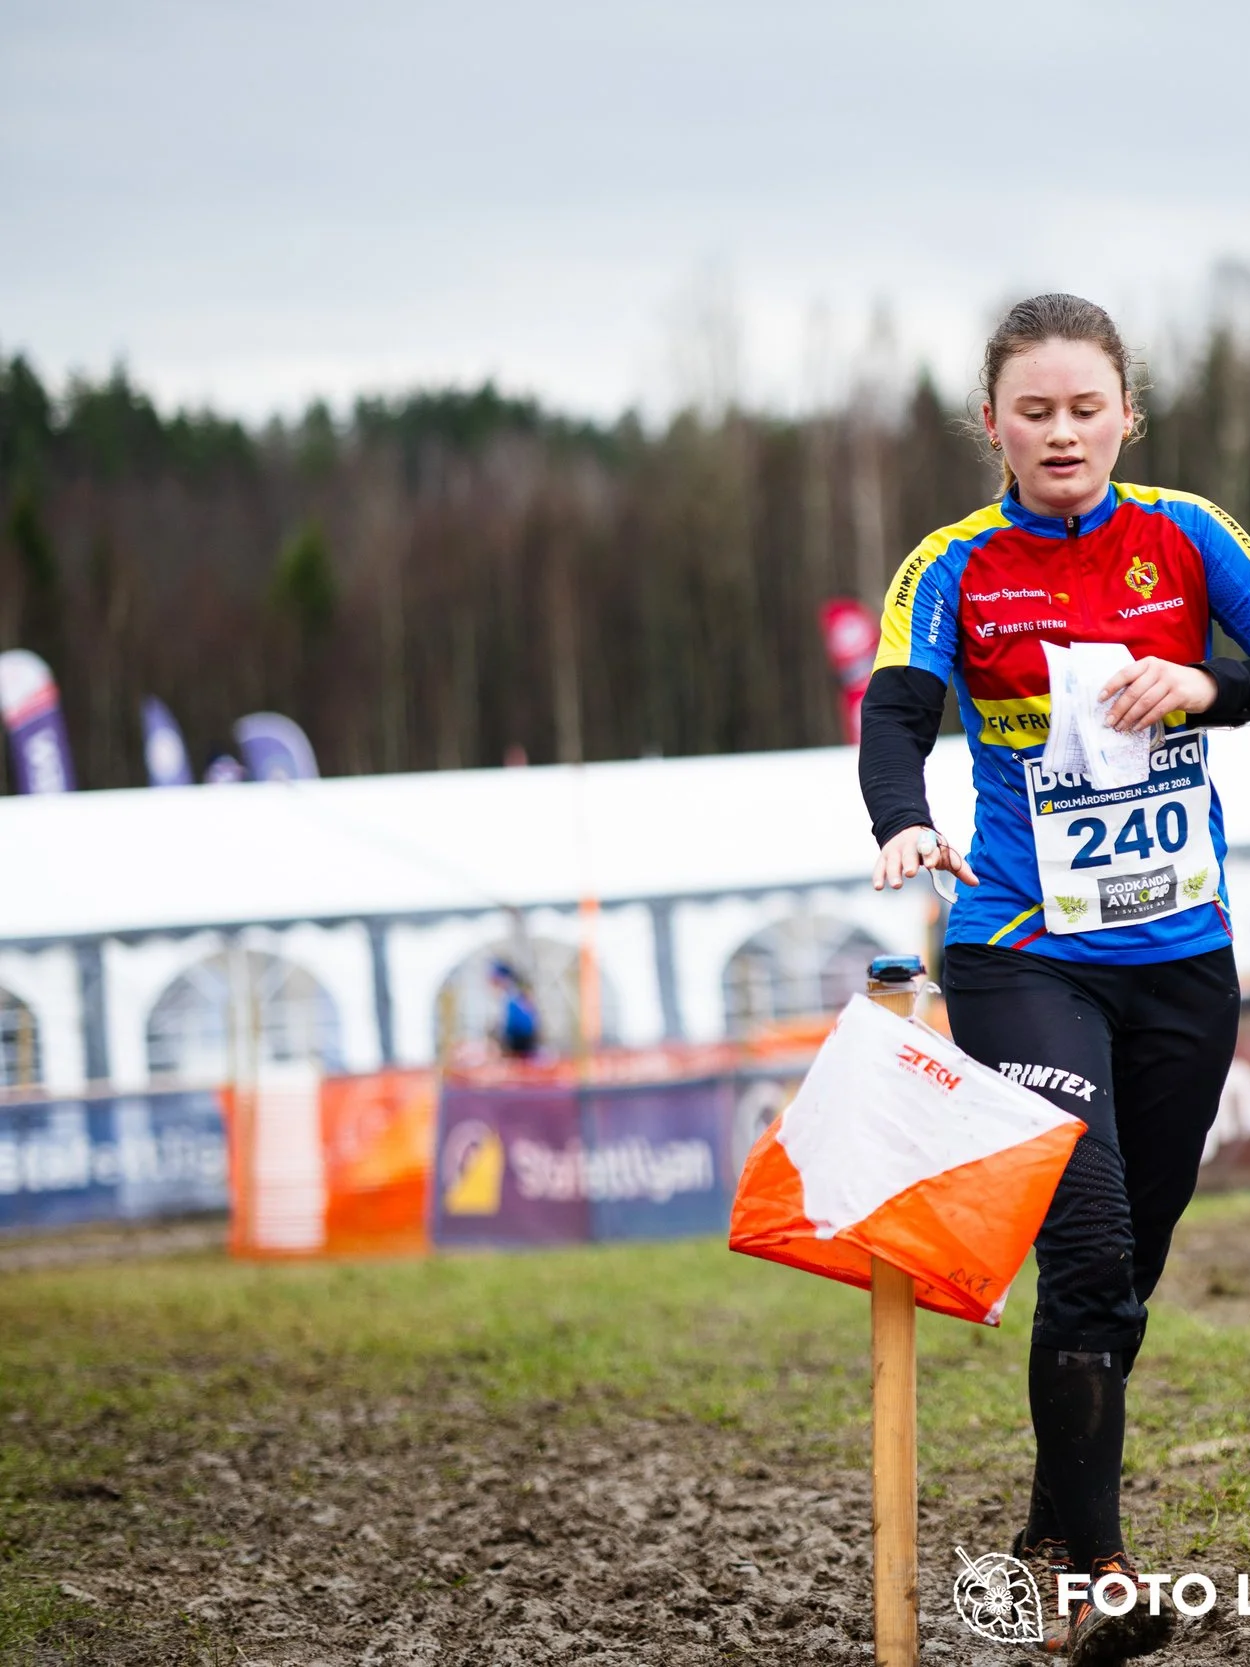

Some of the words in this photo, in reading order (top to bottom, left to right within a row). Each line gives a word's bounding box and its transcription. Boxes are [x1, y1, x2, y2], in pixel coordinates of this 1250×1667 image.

[895, 556, 926, 607] TRIMTEX
[1002, 588, 1046, 600] Sparbank
[1118, 597, 1184, 619] VARBERG
[998, 621, 1034, 634] VARBERG
[1036, 619, 1067, 630] ENERGI
[1054, 787, 1141, 810] KOLMÅRDSMEDELN
[1148, 785, 1159, 794] SL
[1159, 781, 1170, 792] #2
[1171, 776, 1191, 789] 2026
[1067, 801, 1188, 870] 240
[1106, 873, 1172, 895] GODKÄNDA
[1107, 883, 1170, 909] AVLOPP
[999, 1062, 1097, 1101] TRIMTEX
